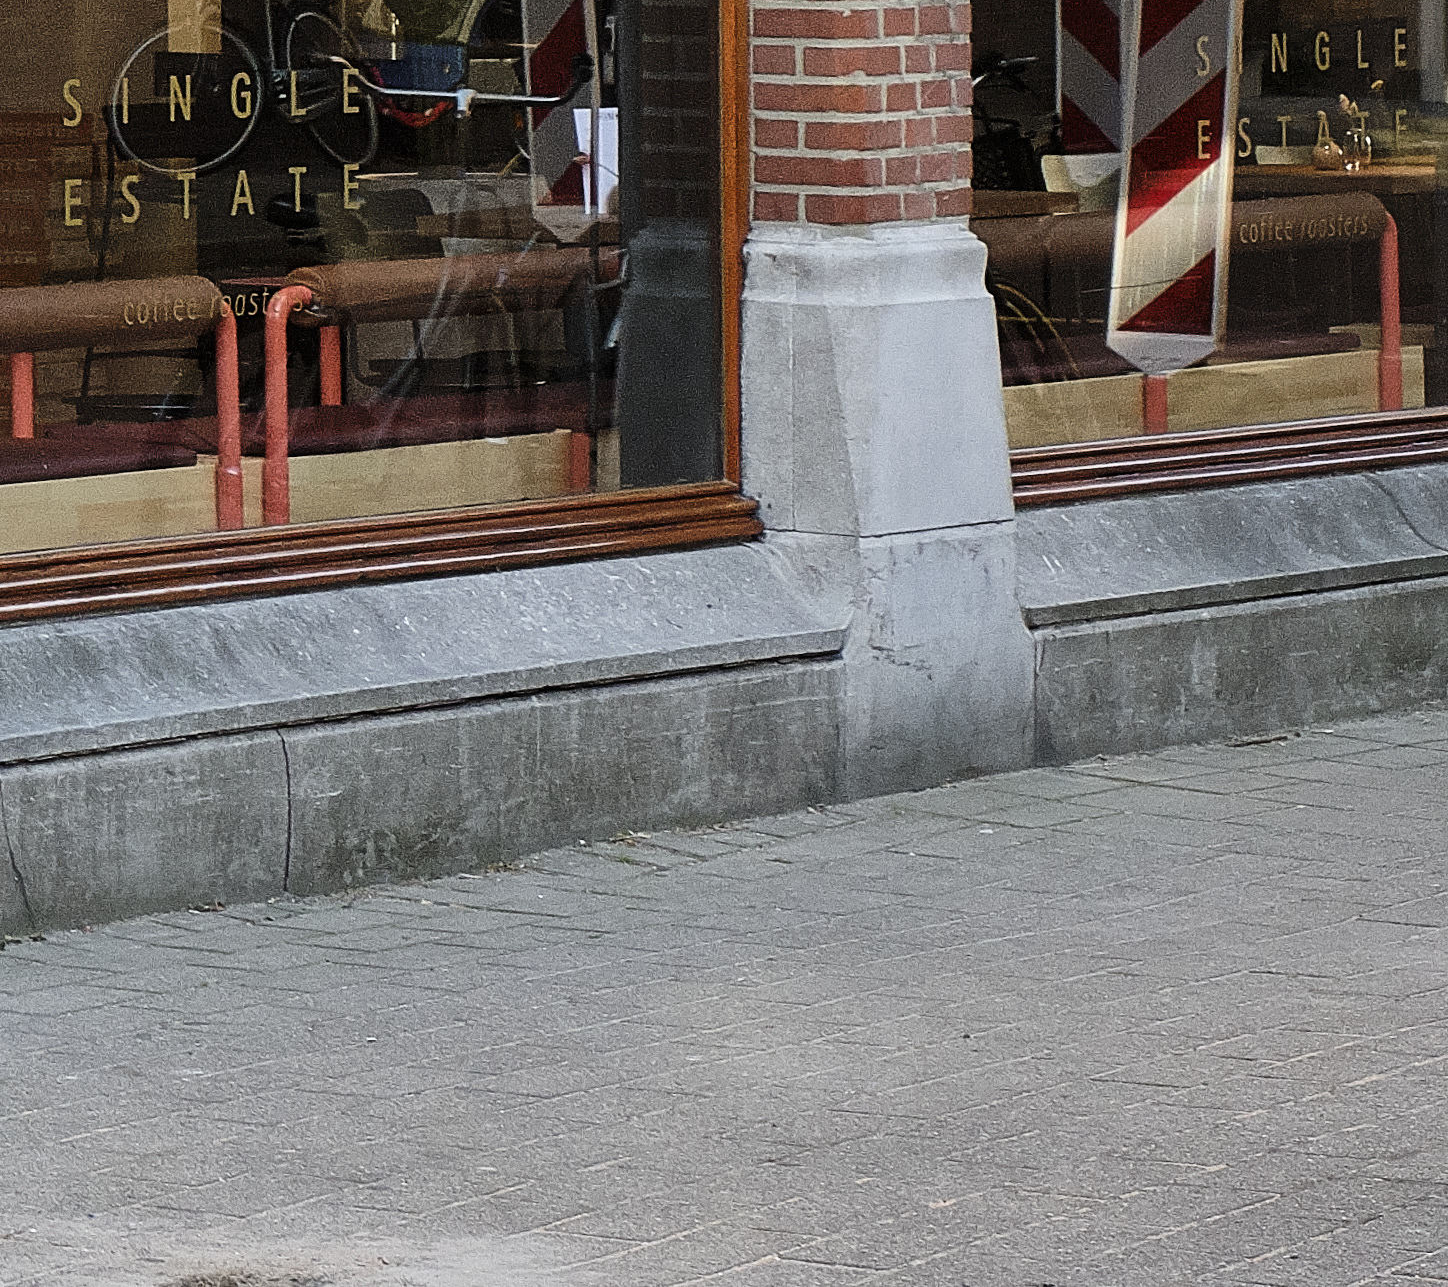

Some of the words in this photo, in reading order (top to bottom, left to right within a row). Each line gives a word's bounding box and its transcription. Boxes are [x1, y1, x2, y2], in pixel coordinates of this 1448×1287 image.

[1196, 28, 1407, 76] SINGLE
[63, 68, 360, 127] SINGLE
[1197, 109, 1407, 160] ESTATE
[64, 163, 360, 226] ESTATE
[210, 287, 303, 318] roasts
